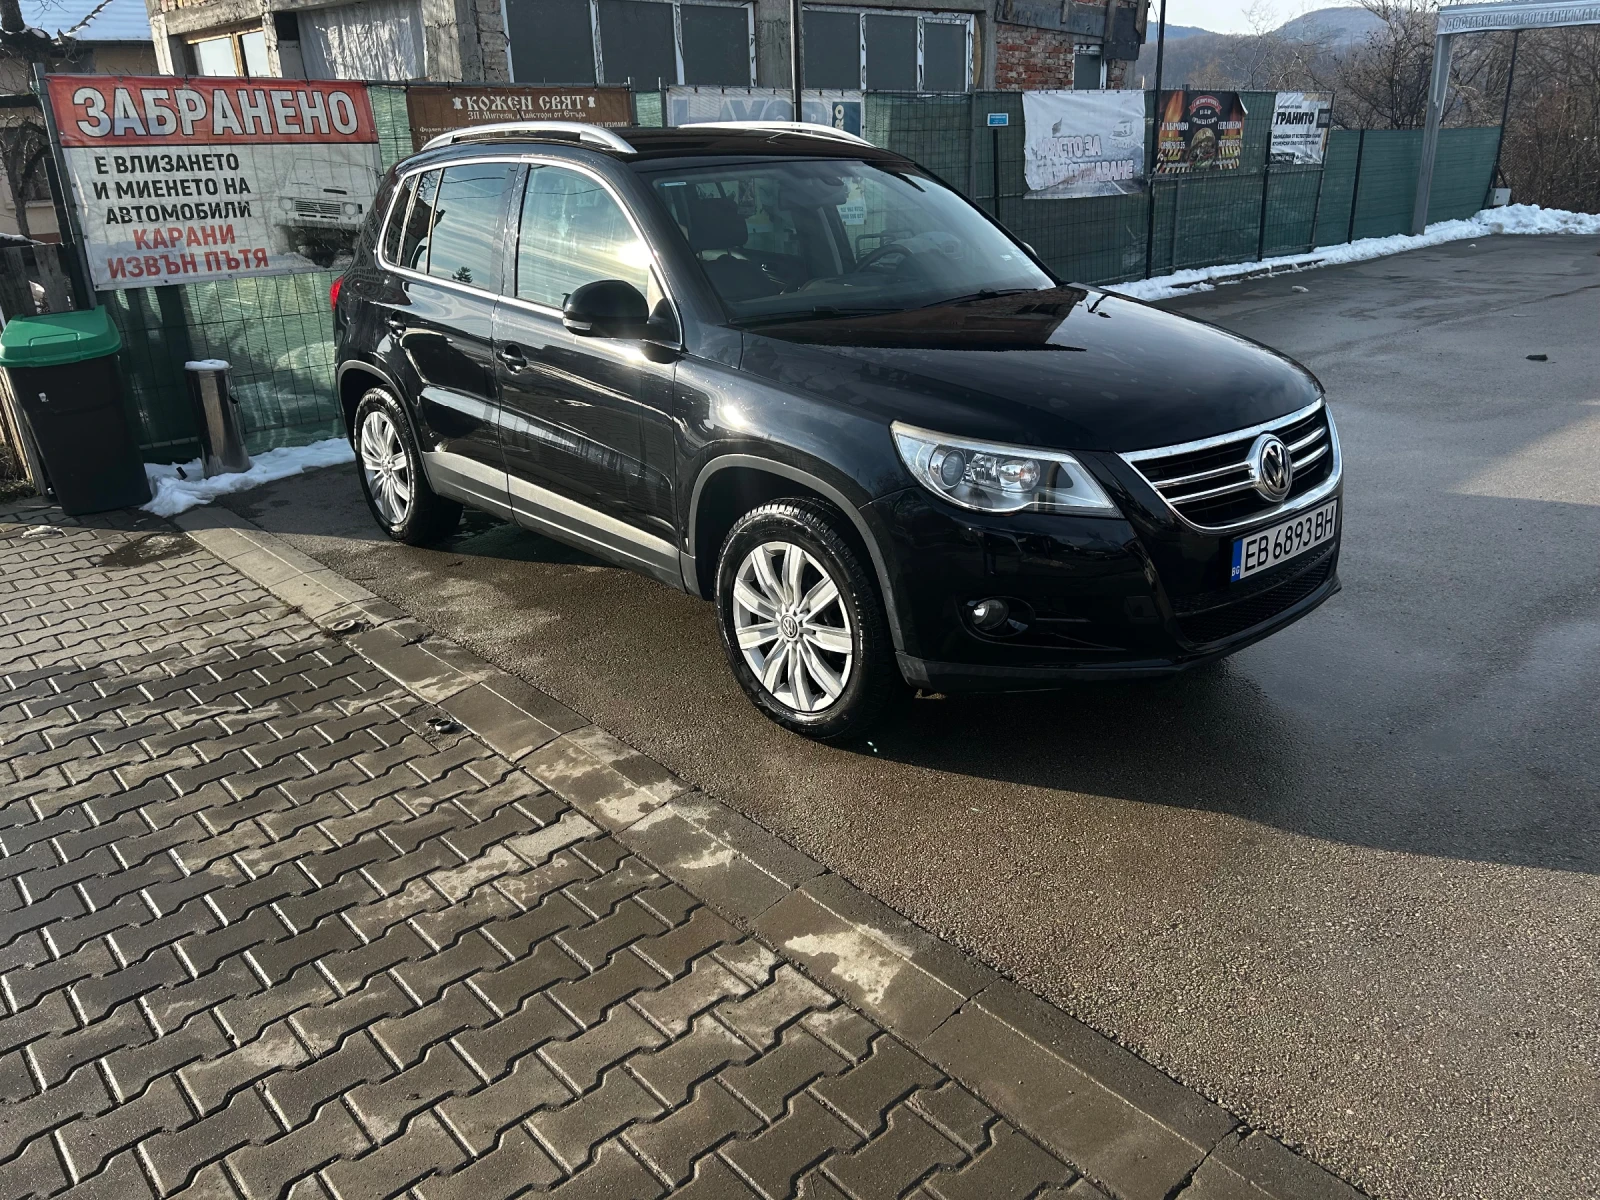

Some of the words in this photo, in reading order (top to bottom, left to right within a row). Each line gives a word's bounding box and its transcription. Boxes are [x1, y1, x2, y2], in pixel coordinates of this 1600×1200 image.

[1445, 16, 1494, 32] ДОСТАВКА
[1495, 13, 1510, 26] НА
[1510, 9, 1575, 25] СТРОИТЕЛНИ
[72, 86, 359, 138] ЗАБРАНЕНО
[465, 95, 533, 111] КОЖЕН
[539, 95, 584, 111] СВЯТ
[553, 111, 562, 119] от
[1275, 111, 1315, 125] ГРАНИТО
[1084, 134, 1102, 158] ЗА
[95, 155, 109, 175] Е
[115, 152, 240, 174] ВЛИЗАНЕТО
[93, 181, 108, 200] И
[116, 177, 218, 200] МИЕНЕТО
[225, 176, 251, 195] НА
[106, 200, 252, 225] АВТОМОБИЛИ
[132, 224, 236, 251] КАРАНИ
[107, 251, 198, 279] ИЗВЪН
[205, 247, 269, 273] ПЪТЯ
[1244, 535, 1269, 573] EB
[1272, 516, 1313, 560] 6893
[1314, 505, 1334, 542] BH
[1231, 566, 1240, 577] BG
